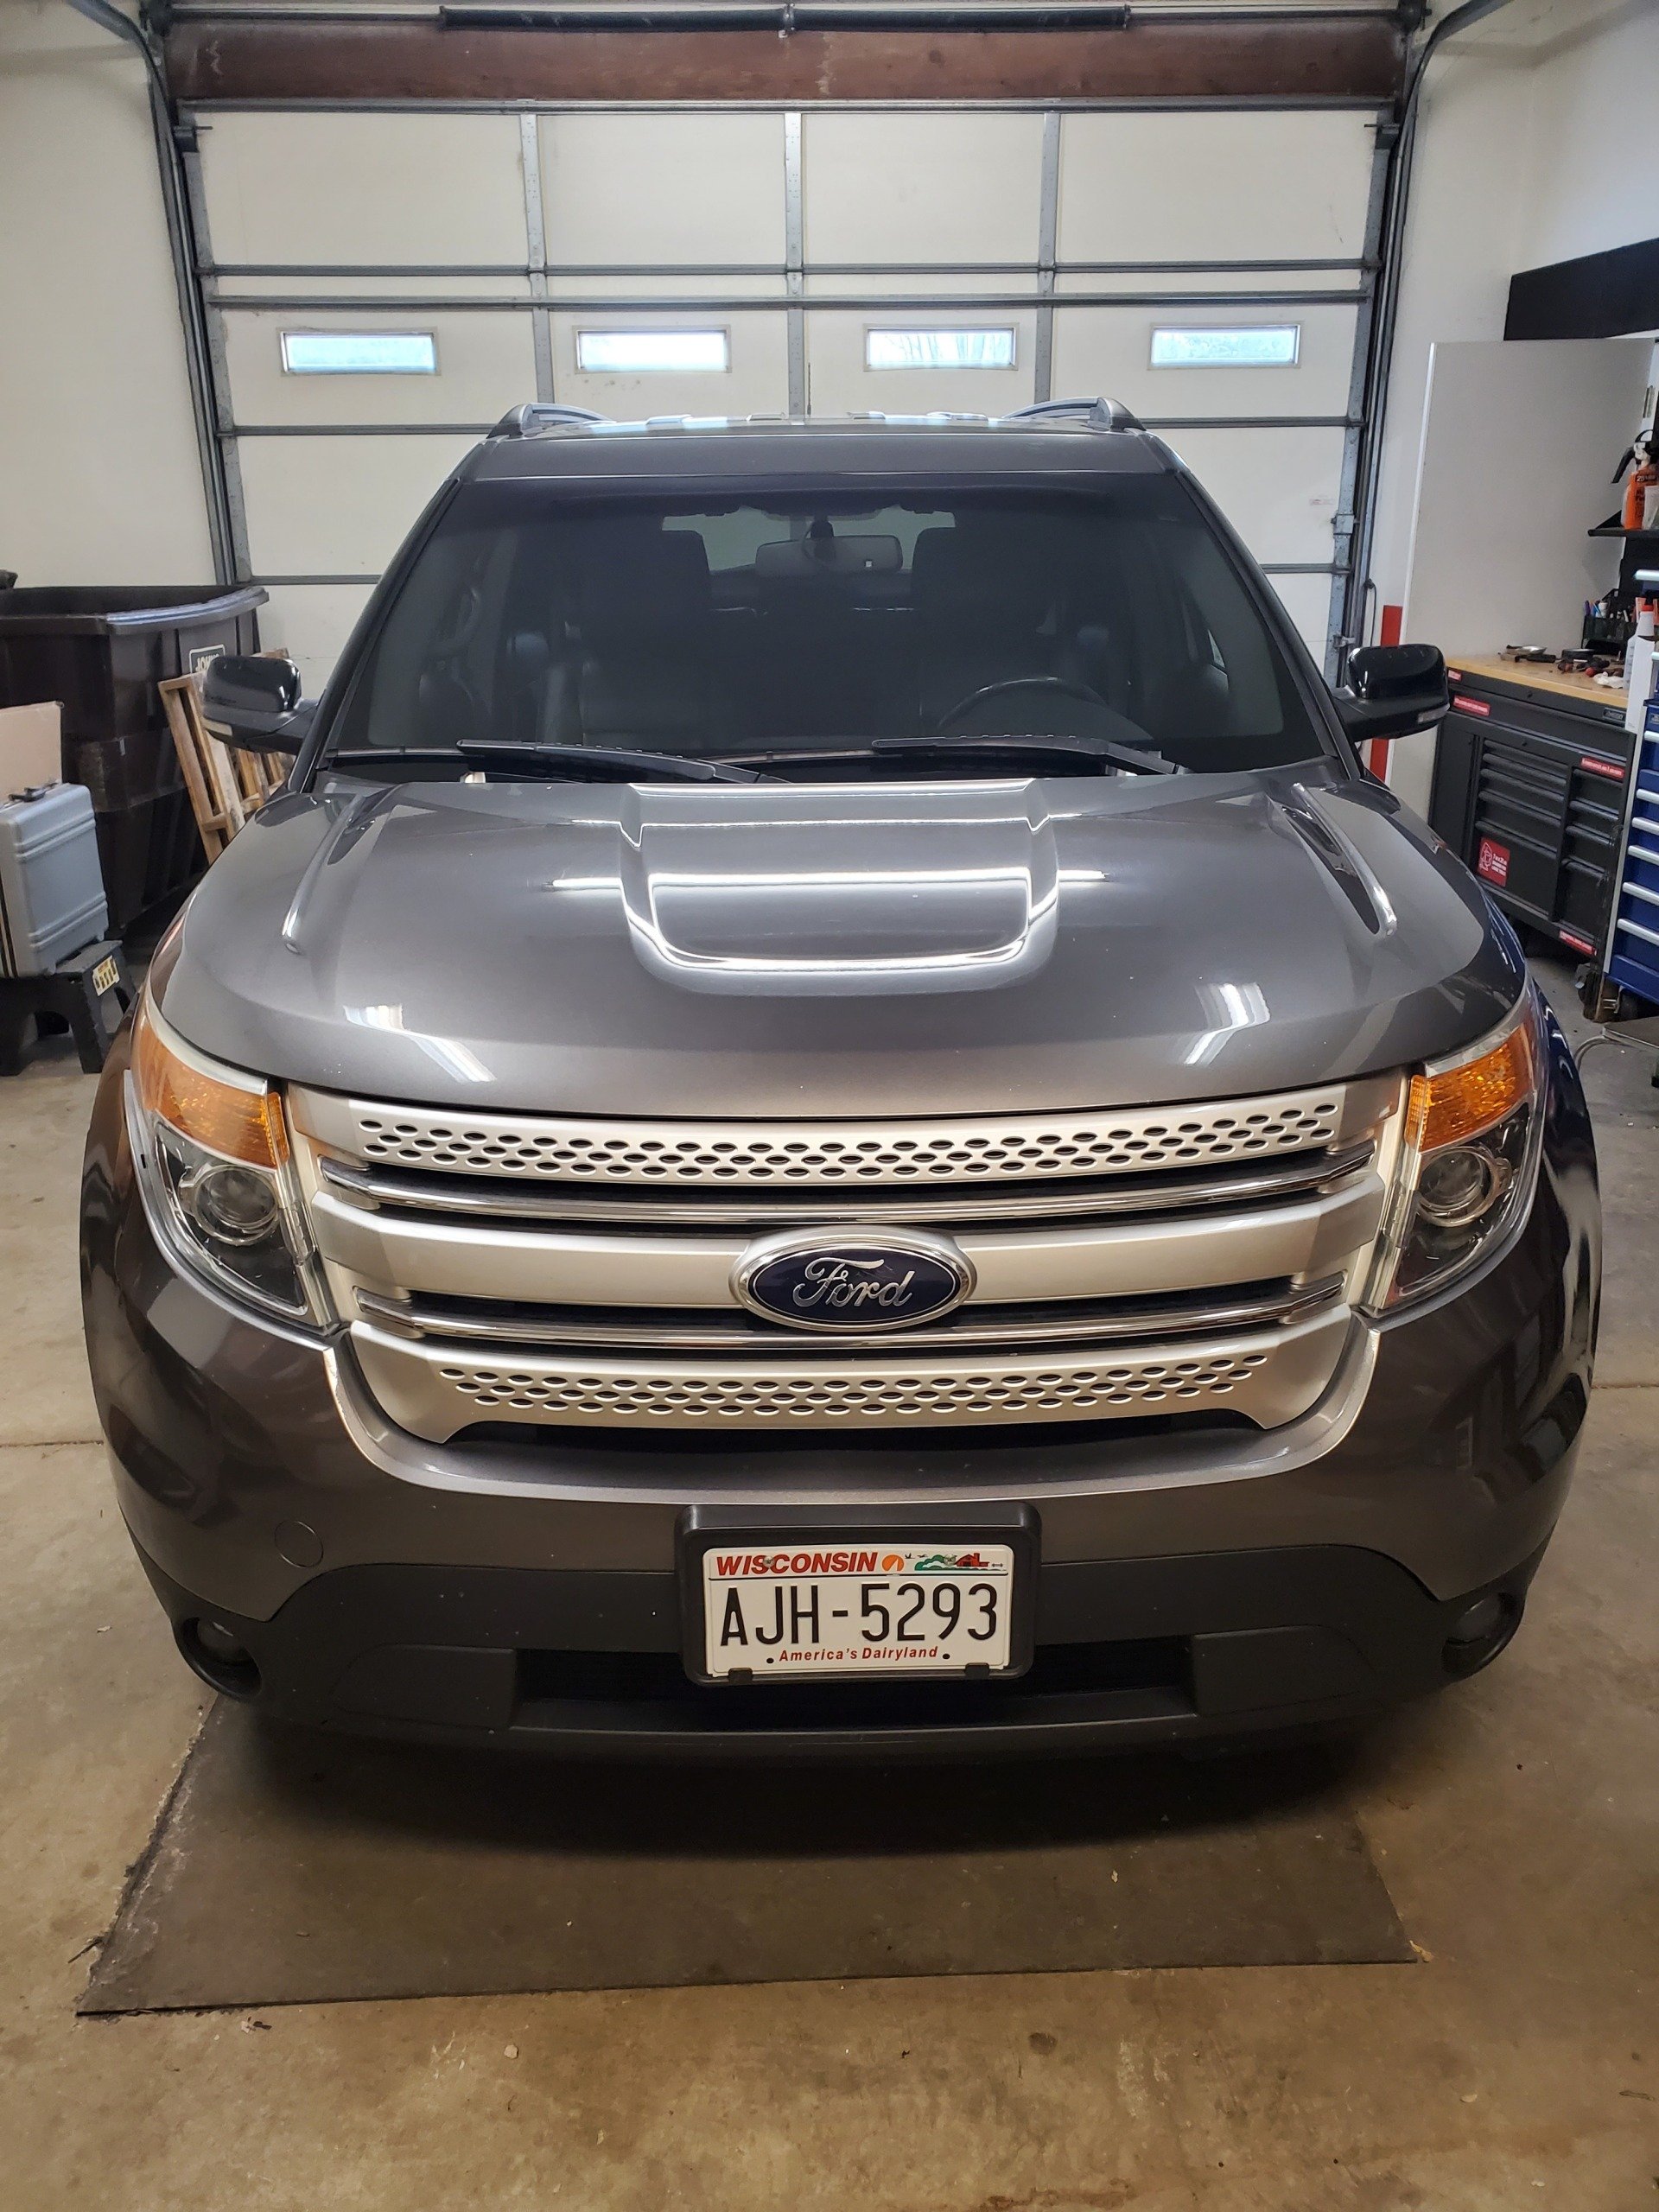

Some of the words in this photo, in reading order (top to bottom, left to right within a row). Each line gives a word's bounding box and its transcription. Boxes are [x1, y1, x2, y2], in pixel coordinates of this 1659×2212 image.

[792, 1256, 916, 1307] Ford
[716, 1552, 879, 1576] WISCONSIN
[720, 1582, 998, 1647] AJH-5293
[779, 1648, 858, 1662] America's
[861, 1646, 938, 1662] Dairyland
